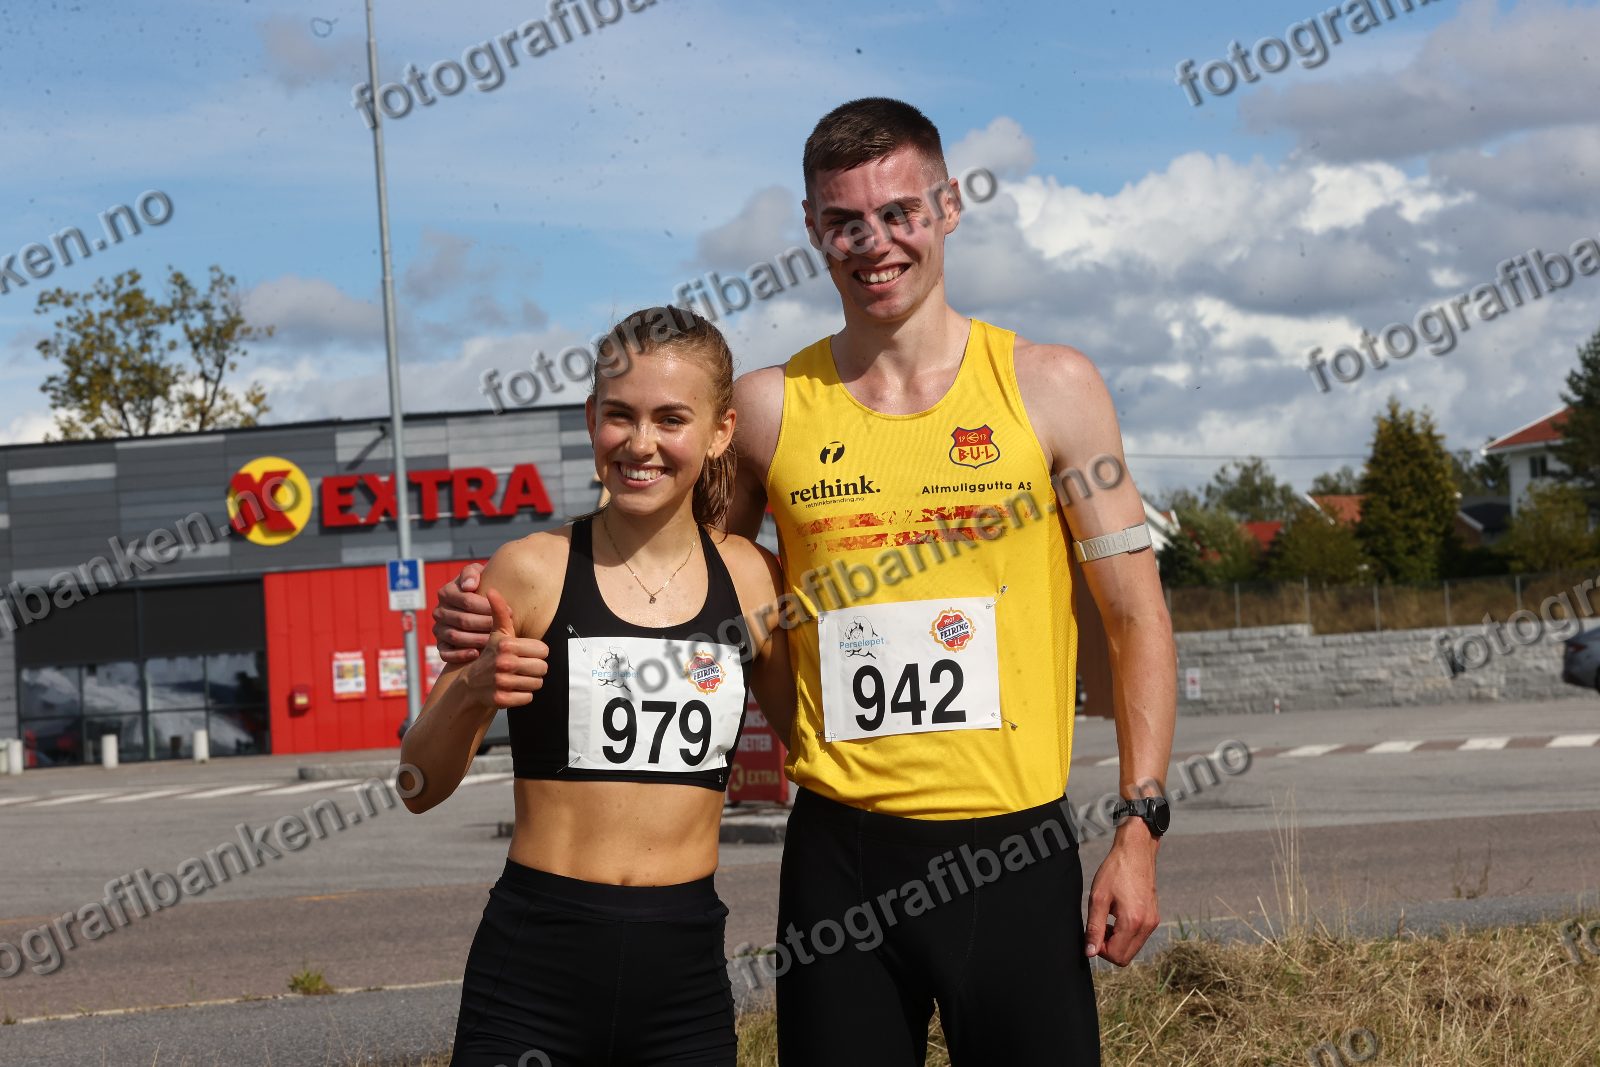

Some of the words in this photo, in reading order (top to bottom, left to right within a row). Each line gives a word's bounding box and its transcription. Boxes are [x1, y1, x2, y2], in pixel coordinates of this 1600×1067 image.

[321, 463, 554, 527] EXTRA
[790, 475, 881, 506] rethink.
[921, 481, 1012, 495] Altmuliggutta
[1018, 482, 1032, 491] AS
[805, 497, 865, 509] rethinkbranding.no
[940, 621, 969, 640] FEIRING
[839, 637, 885, 650] Perseløpet
[693, 665, 720, 681] FEIRING
[852, 658, 967, 732] 942
[602, 696, 712, 767] 979
